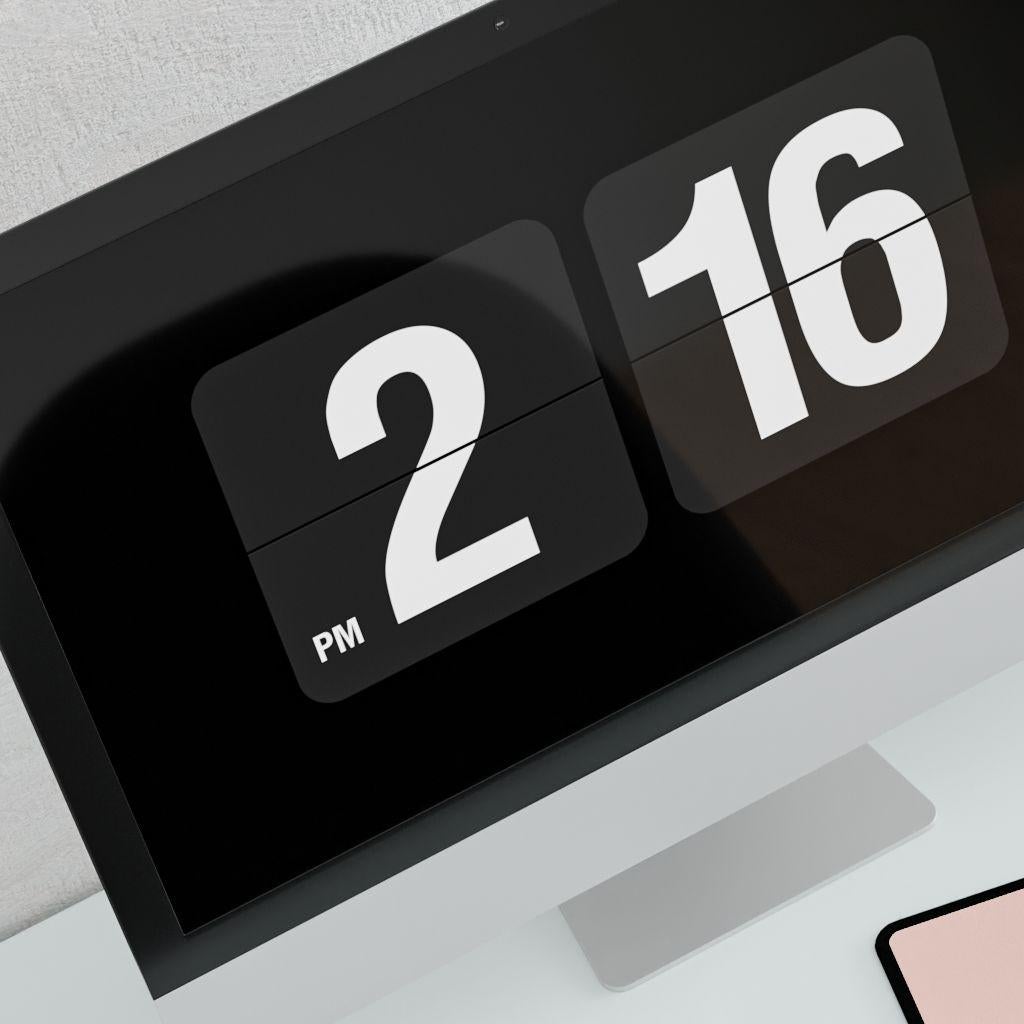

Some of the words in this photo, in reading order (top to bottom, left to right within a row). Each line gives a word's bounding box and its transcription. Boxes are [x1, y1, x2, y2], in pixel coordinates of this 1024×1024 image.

[326, 325, 541, 625] 2
[638, 107, 949, 440] 16
[312, 616, 365, 664] PM
